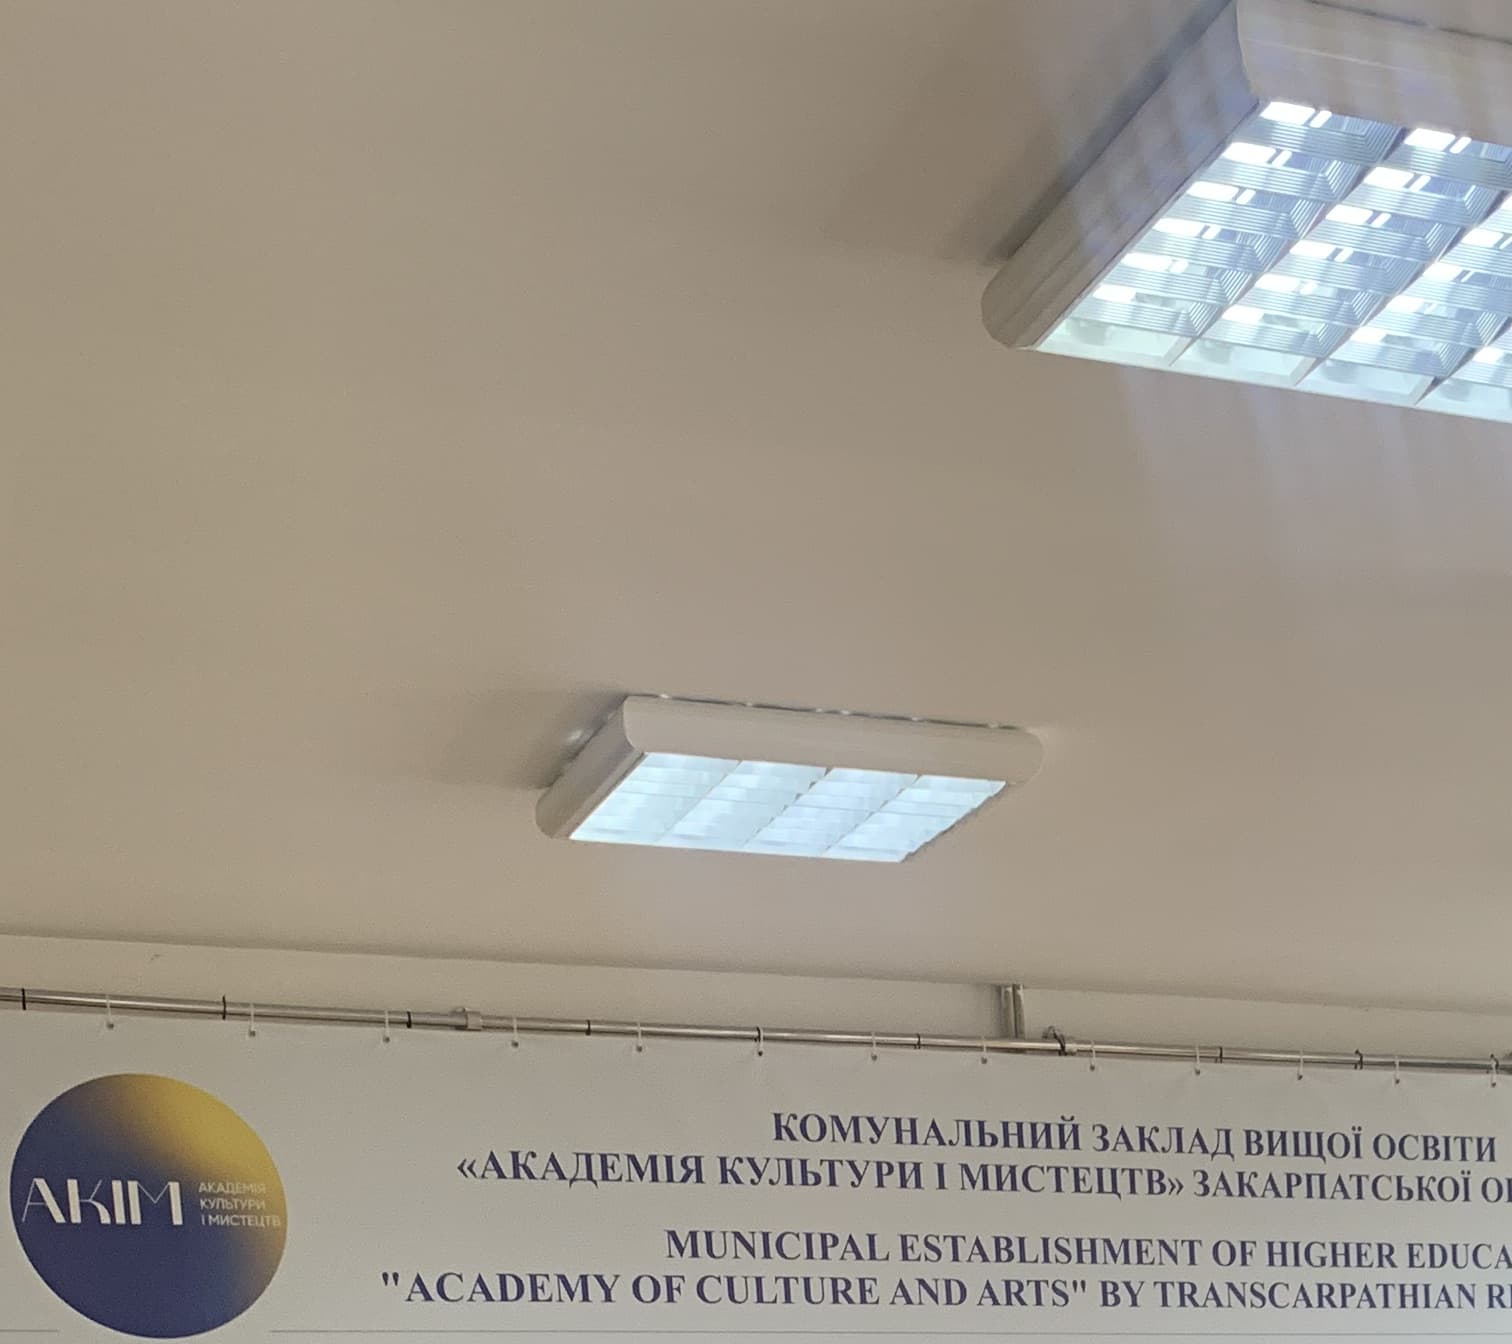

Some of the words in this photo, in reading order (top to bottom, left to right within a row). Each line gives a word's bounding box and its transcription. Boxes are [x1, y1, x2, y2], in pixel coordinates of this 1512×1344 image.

[773, 1112, 1082, 1151] КОМУНАЛЬНИЙ
[1092, 1125, 1235, 1160] ЗАКЛАД
[1244, 1126, 1362, 1162] ВИЩОЇ
[1373, 1132, 1497, 1163] ОСВІТИ
[198, 1181, 267, 1195] АКАДЕМІЯ
[457, 1150, 704, 1188] «АКАДЕМІЯ
[718, 1155, 923, 1190] КУЛЬТУРИ
[959, 1163, 1184, 1200] МИСТЕЦТВ»
[1193, 1168, 1471, 1202] ЗАКАРПАТСЬКОЇ
[200, 1197, 266, 1212] КУЛЬТУРИ
[208, 1214, 281, 1228] МИСТЕЦТВ
[664, 1230, 890, 1263] MUNICIPAL
[899, 1233, 1203, 1267] ESTABLISHMENT
[1211, 1239, 1257, 1267] OF
[1266, 1241, 1398, 1269] HIGHER
[381, 1271, 621, 1303] "ACADEMY
[631, 1274, 686, 1304] OF
[695, 1274, 880, 1306] CULTURE
[889, 1277, 968, 1307] AND
[976, 1278, 1087, 1308] ARTS"
[1100, 1280, 1145, 1308] BY
[1154, 1281, 1477, 1310] TRANSCARPATHIAN
